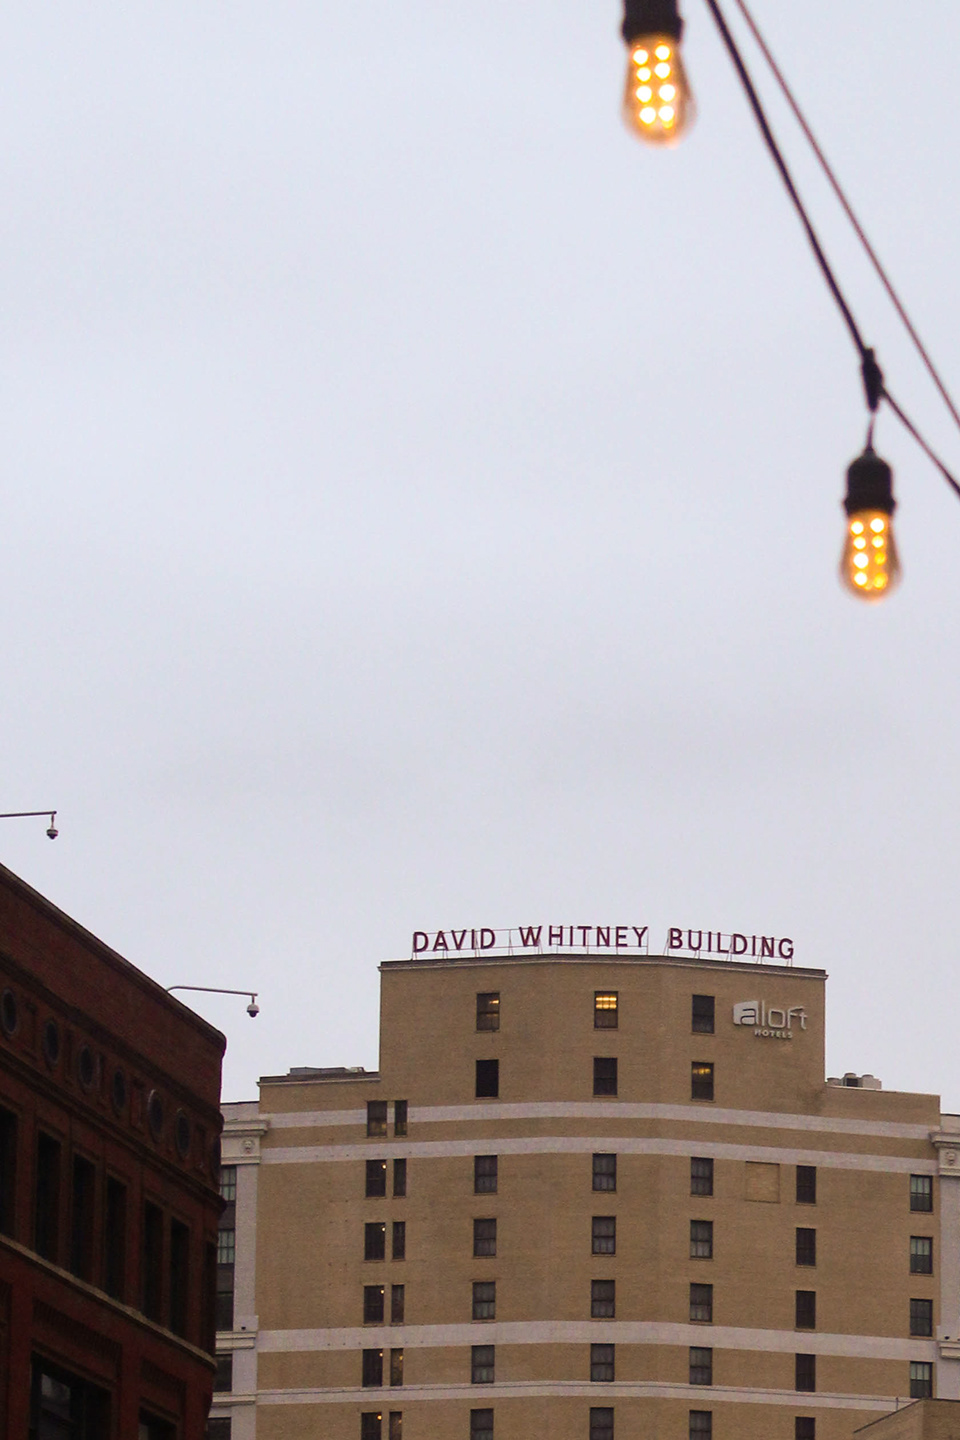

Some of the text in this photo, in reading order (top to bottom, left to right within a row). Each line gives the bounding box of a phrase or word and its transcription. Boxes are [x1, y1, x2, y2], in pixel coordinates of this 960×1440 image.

[413, 925, 794, 960] DAVID WHITNEY BUILDING
[733, 1000, 807, 1030] aloft
[754, 1029, 793, 1039] HOTELS
